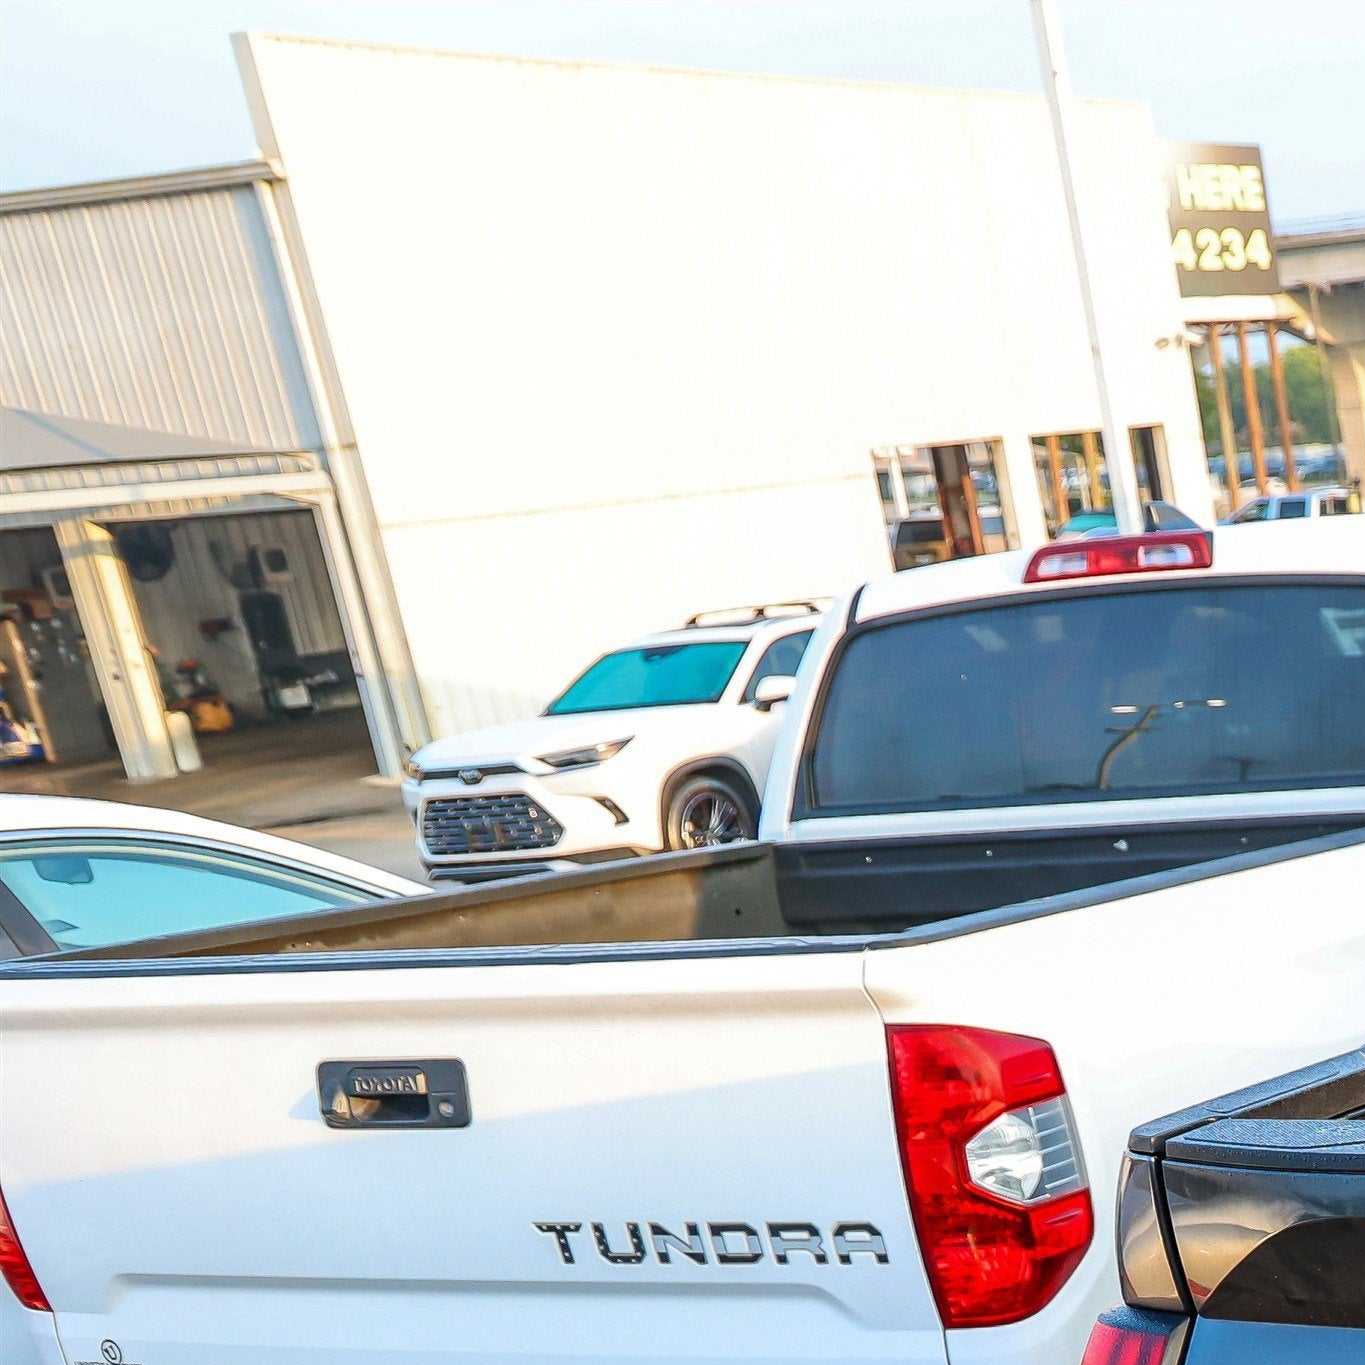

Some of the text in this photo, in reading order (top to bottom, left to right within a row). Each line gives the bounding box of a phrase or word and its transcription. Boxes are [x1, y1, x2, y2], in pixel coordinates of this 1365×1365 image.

[1175, 163, 1267, 212] HERE
[1171, 227, 1274, 272] 4234
[353, 1074, 418, 1094] TOYOTA
[531, 1221, 891, 1265] TUNDRA
